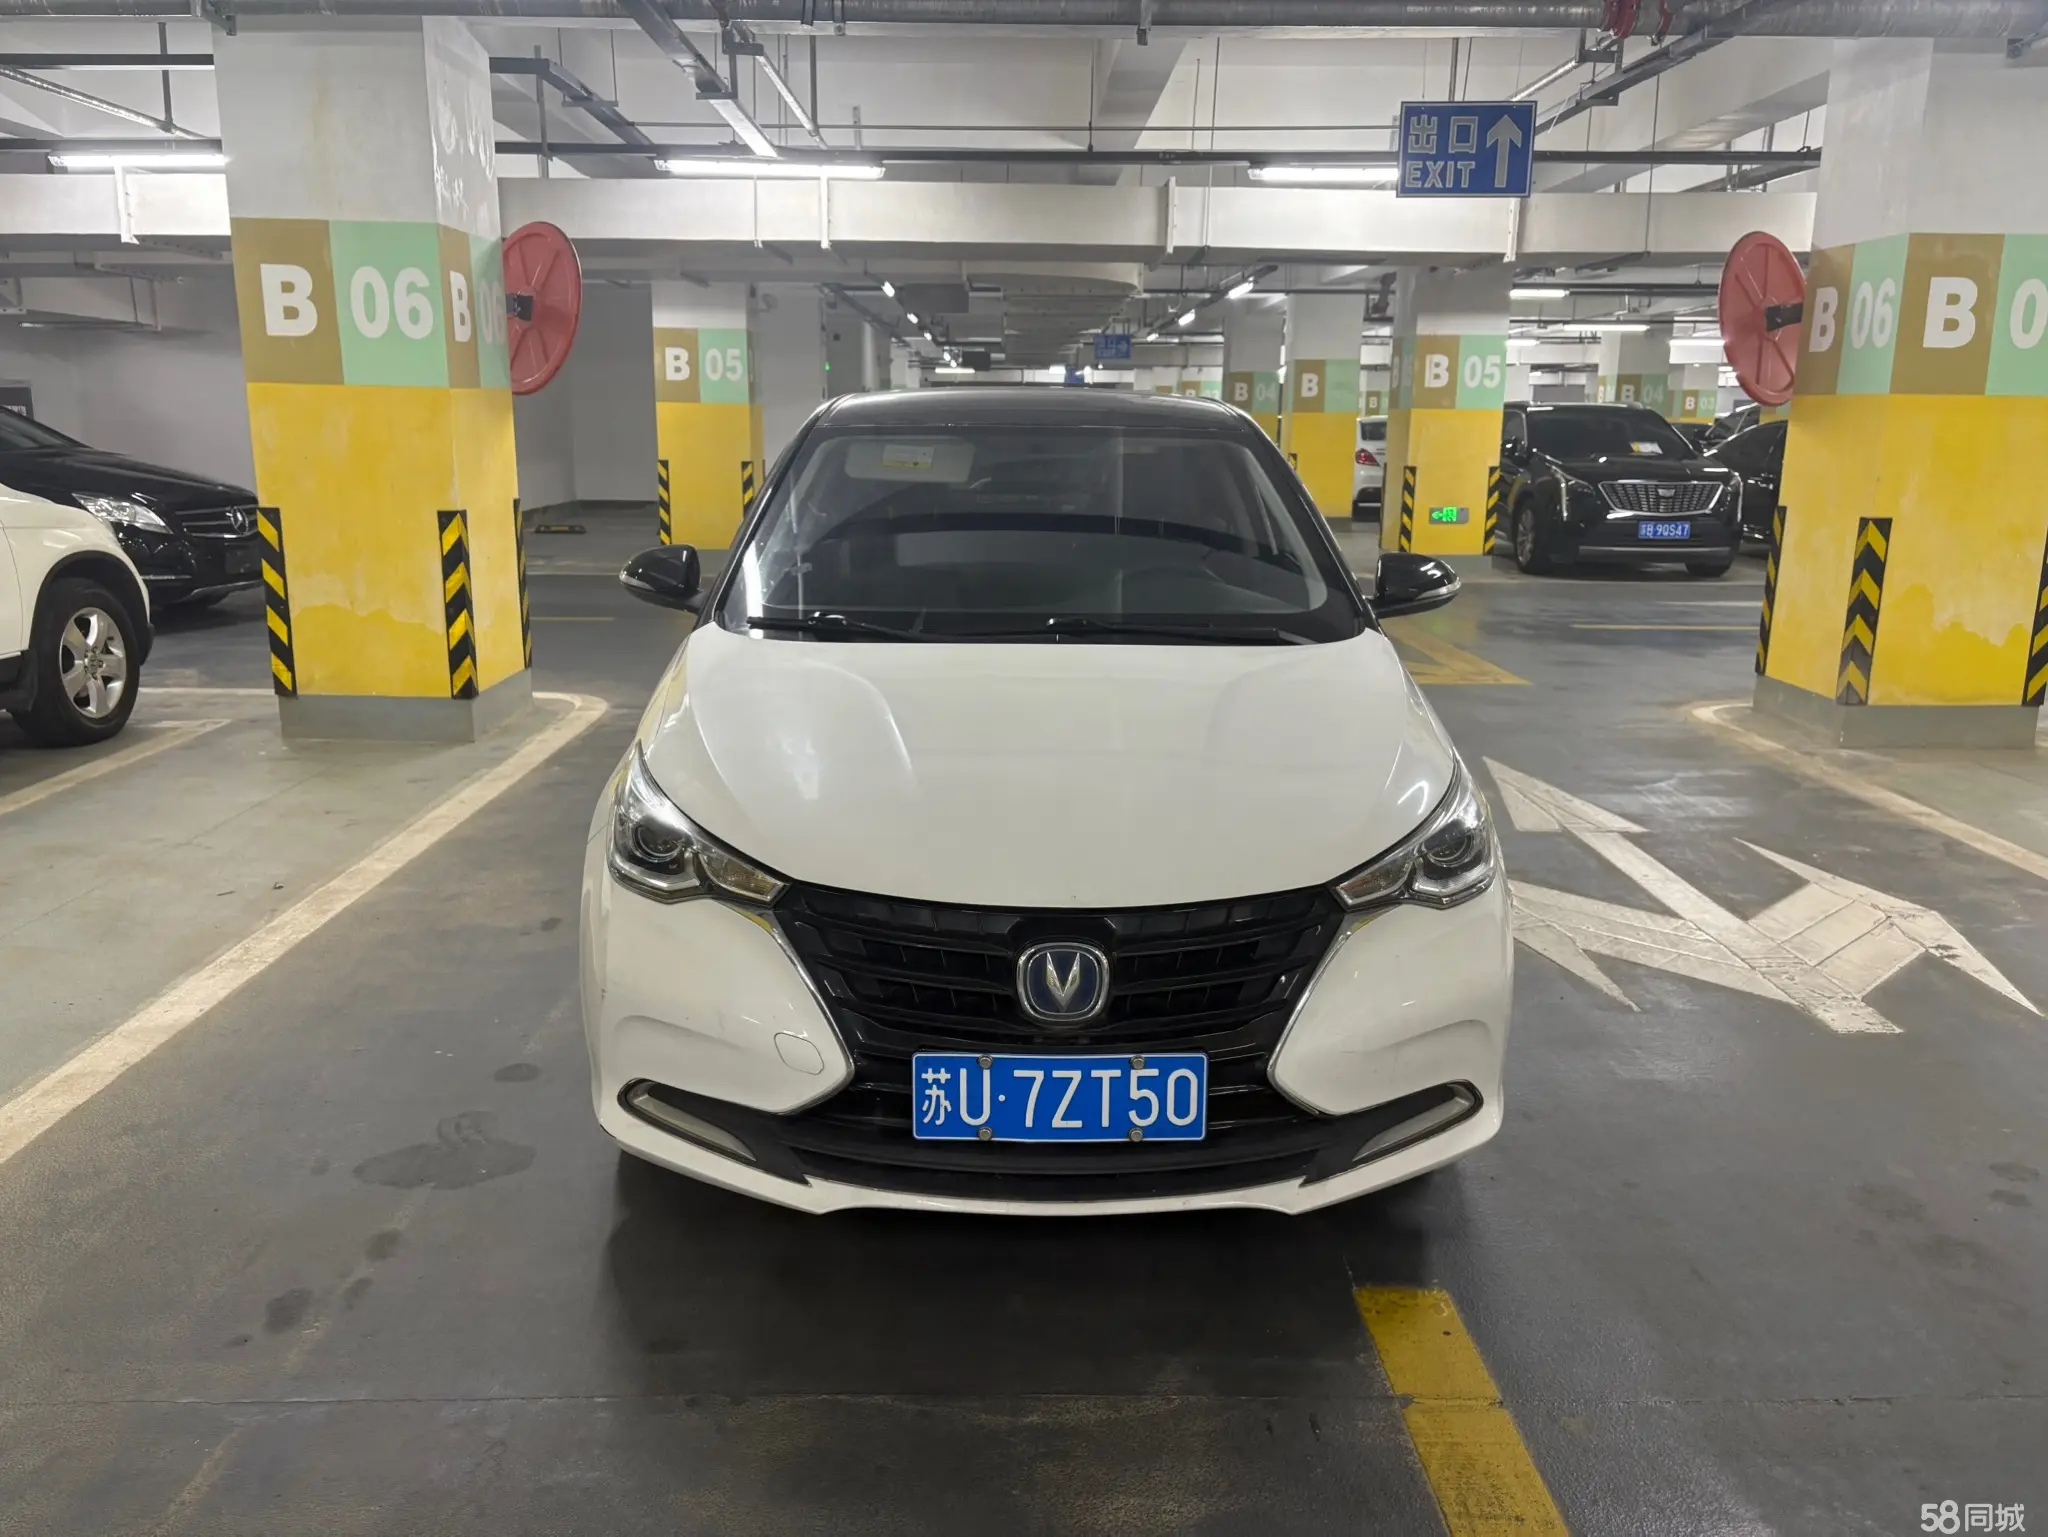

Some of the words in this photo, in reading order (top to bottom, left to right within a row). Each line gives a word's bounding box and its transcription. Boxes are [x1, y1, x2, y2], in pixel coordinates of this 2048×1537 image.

[1408, 114, 1478, 154] 出口
[1405, 161, 1475, 188] EXIT
[260, 263, 318, 336] B
[350, 266, 433, 339] 06
[449, 270, 471, 342] B
[1809, 286, 1838, 352] B
[1851, 277, 1896, 349] 06
[1923, 276, 1978, 348] B
[665, 347, 690, 380] B
[705, 348, 743, 381] 05
[1425, 354, 1449, 388] B
[1464, 355, 1501, 388] 05
[1234, 383, 1248, 401] B
[1301, 373, 1318, 397] B
[1620, 385, 1635, 402] B
[921, 1068, 1198, 1128] 苏U·7ZT50
